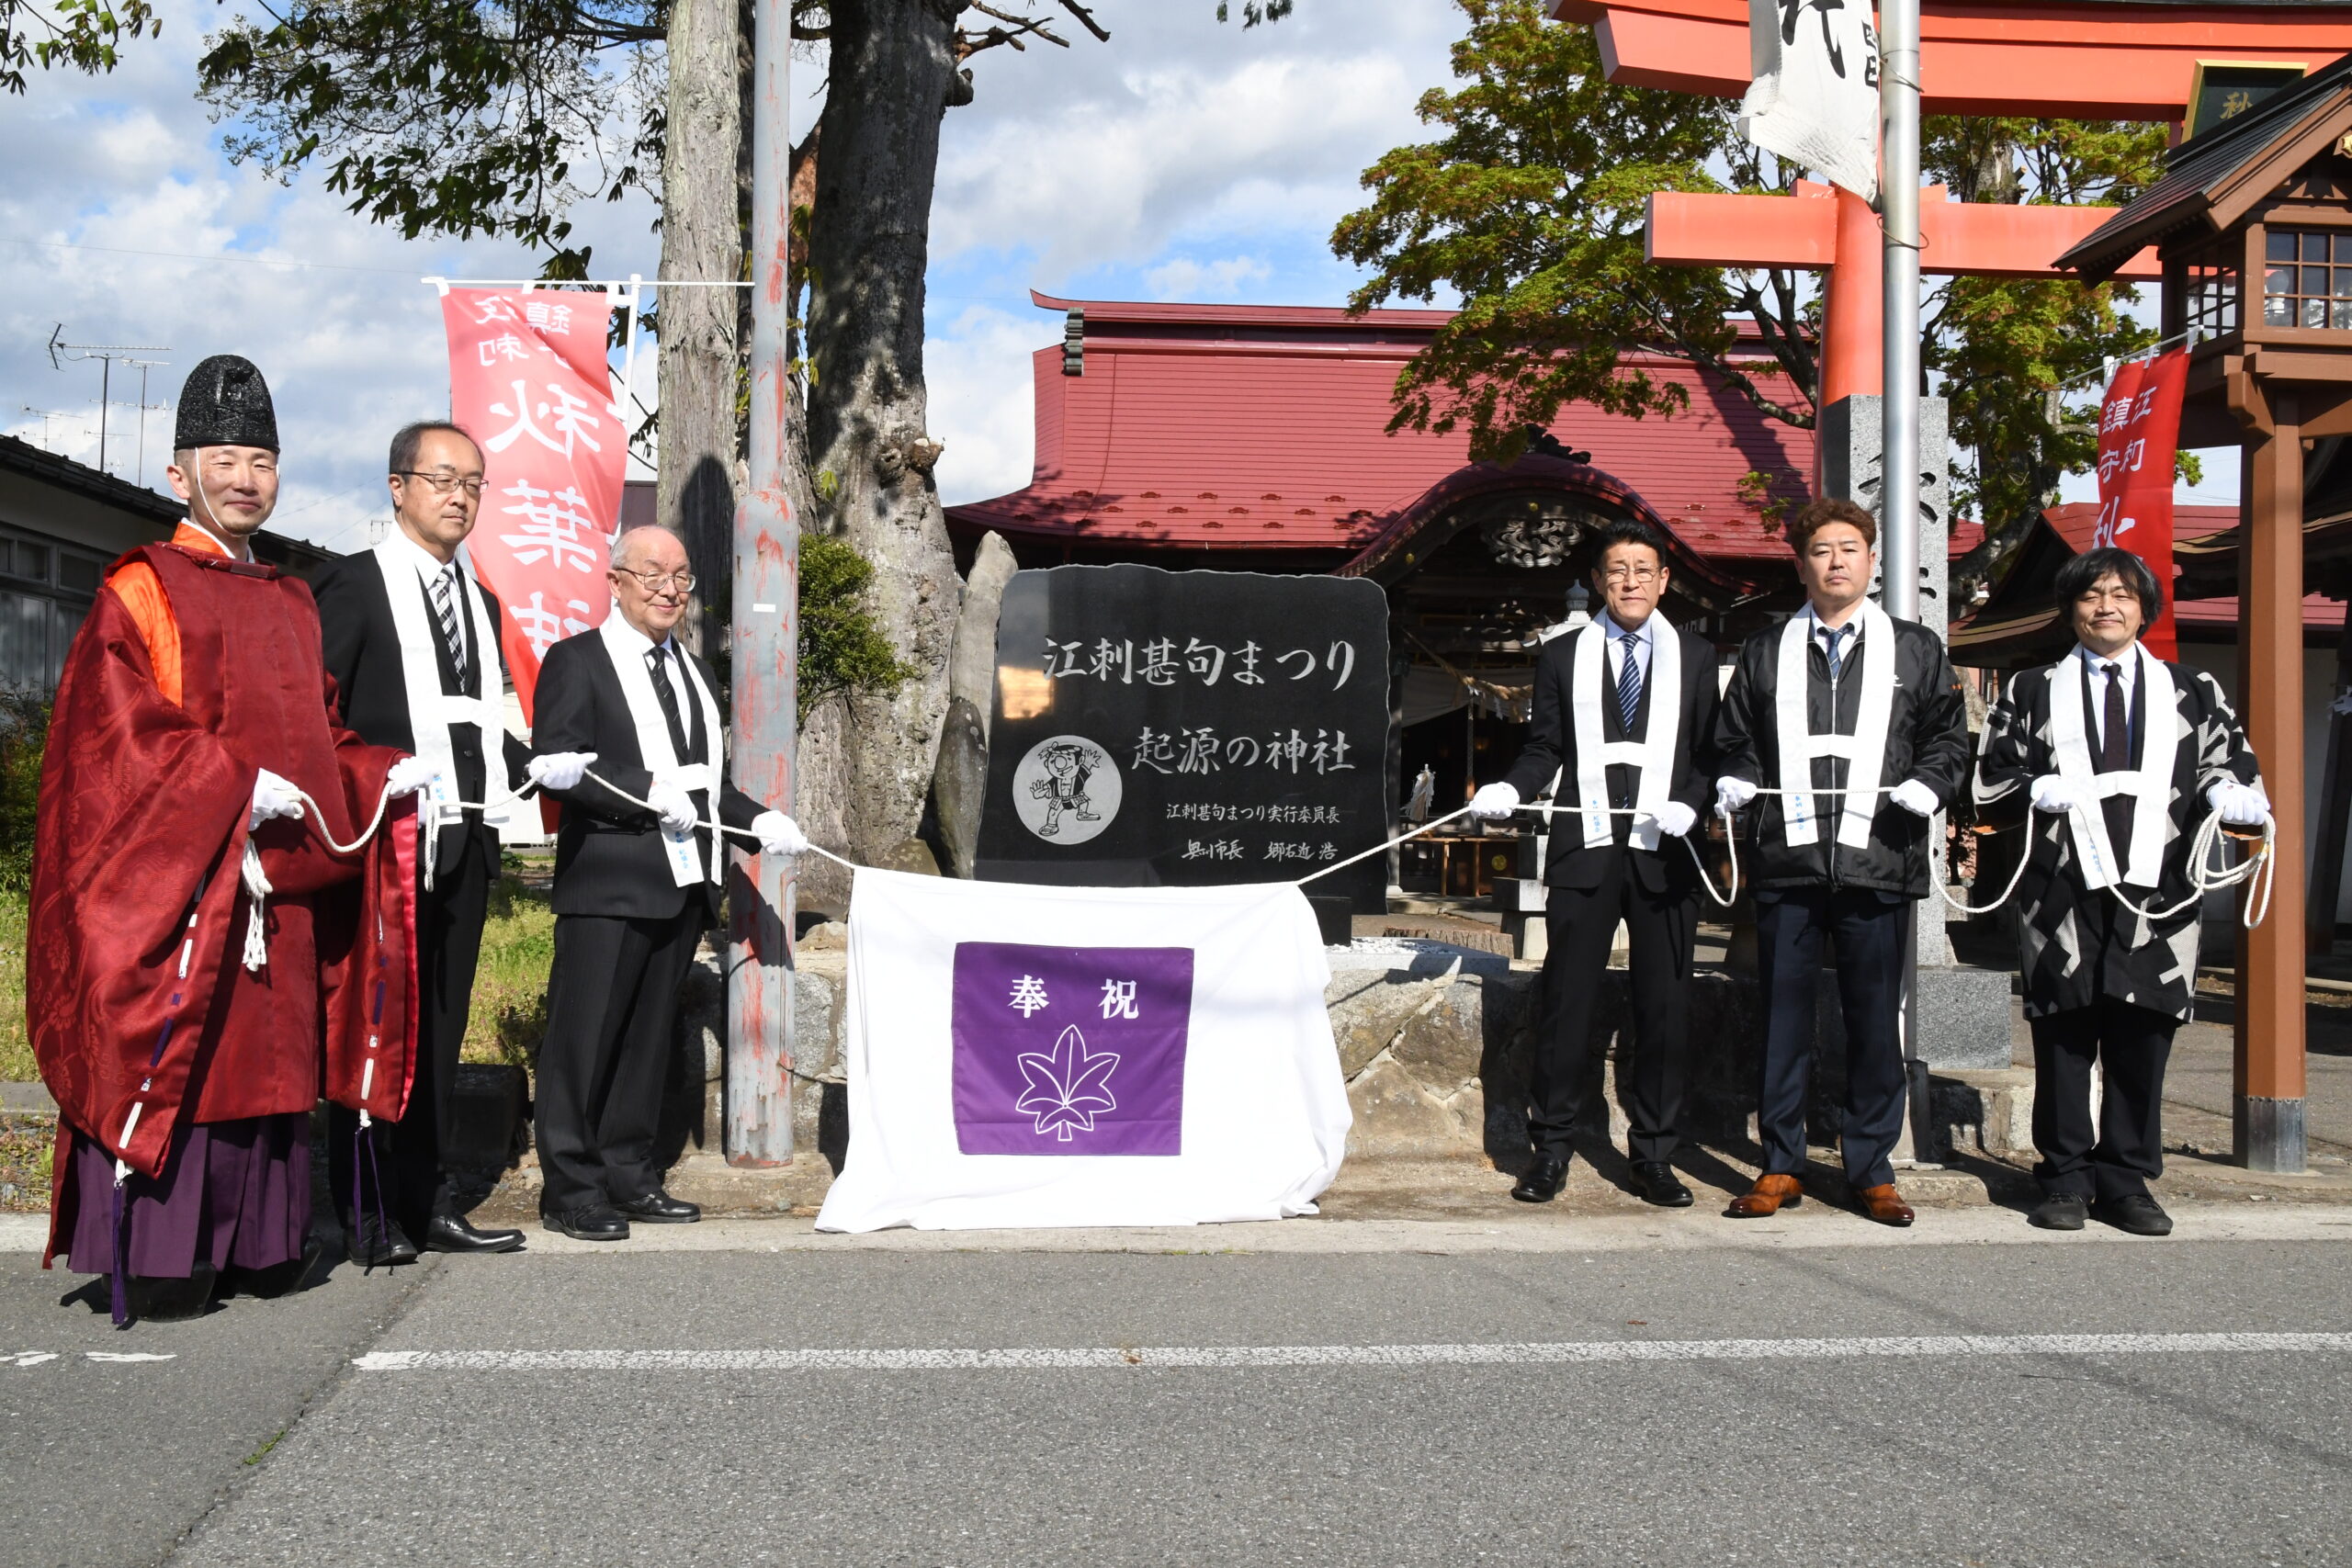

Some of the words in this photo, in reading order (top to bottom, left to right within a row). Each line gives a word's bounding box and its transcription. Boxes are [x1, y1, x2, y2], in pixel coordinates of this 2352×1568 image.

[2219, 91, 2254, 119] 秋
[2099, 396, 2133, 484] 鎮守
[2119, 386, 2157, 473] 江刺
[1042, 636, 1356, 691] 江刺甚句まつり
[1131, 726, 1356, 776] 起源の神社
[1166, 803, 1340, 824] 江刺甚句まつり実行委員長
